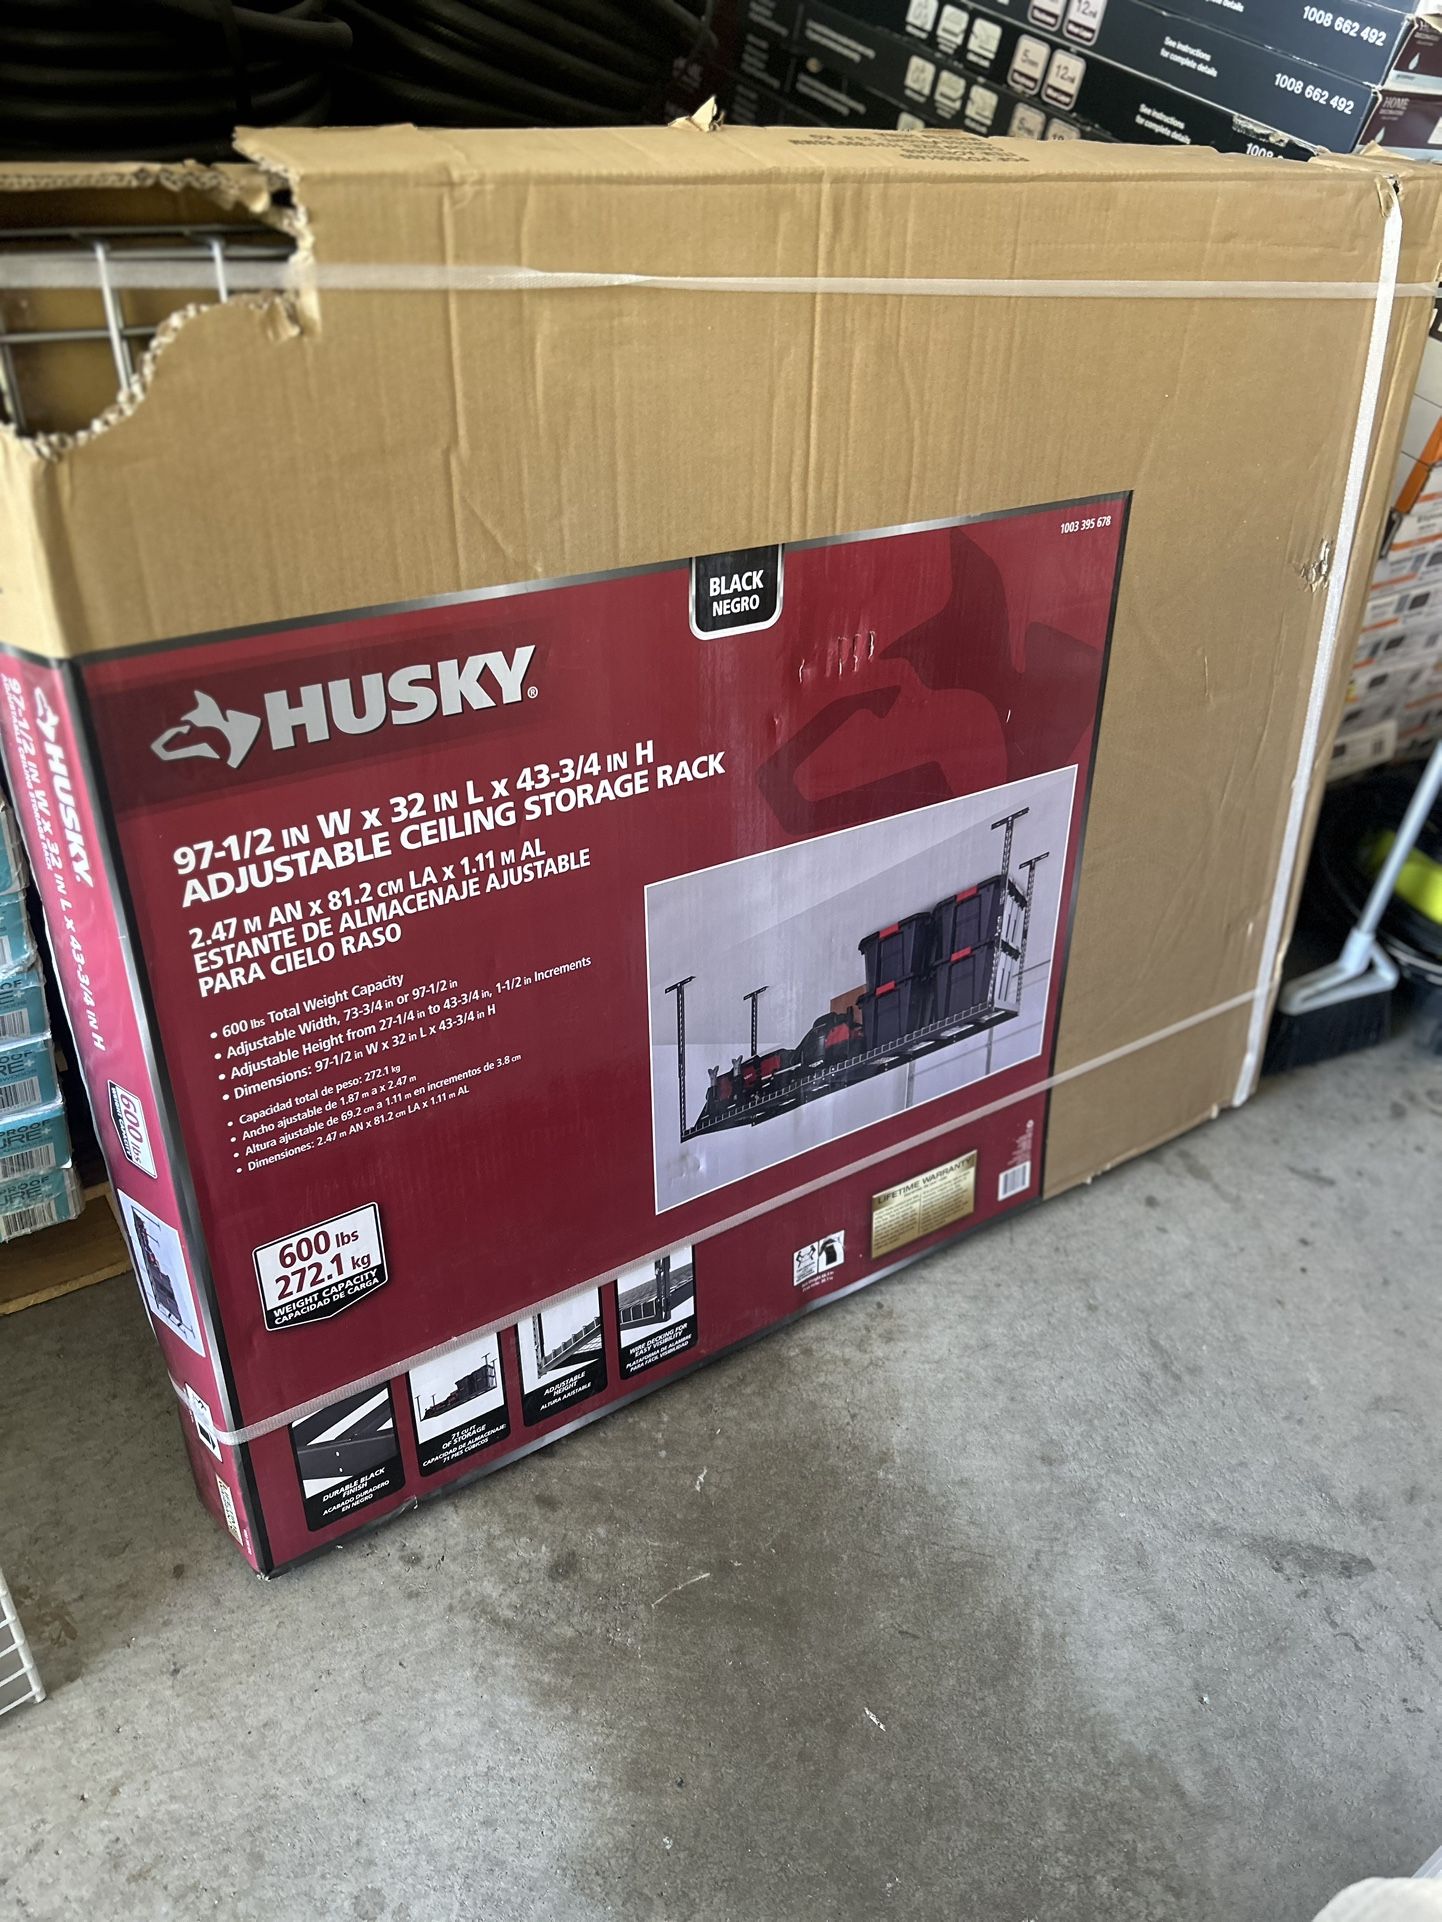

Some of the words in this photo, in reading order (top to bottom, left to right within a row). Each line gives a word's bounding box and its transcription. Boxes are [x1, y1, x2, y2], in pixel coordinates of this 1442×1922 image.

[1303, 5, 1333, 27] 1008
[1334, 15, 1358, 37] 662
[1360, 26, 1387, 47] 492
[1274, 72, 1304, 94] 1008
[1304, 84, 1329, 105] 662
[1329, 94, 1355, 115] 492
[1060, 520, 1079, 534] 1003
[1079, 517, 1095, 530] 395
[1096, 514, 1111, 527] 678
[709, 569, 764, 597] BLACK
[712, 593, 760, 616] NEGRO
[263, 645, 533, 750] HUSKY
[43, 740, 94, 888] HUSKY
[172, 827, 275, 875] 97-1/2
[281, 823, 310, 848] IN
[316, 807, 351, 839] W
[360, 807, 382, 830] x
[389, 791, 426, 823] 32
[432, 789, 458, 812] IN
[465, 779, 484, 805] L
[490, 777, 509, 799] x
[515, 751, 601, 791] 43-3/4
[606, 750, 627, 772] IN
[635, 739, 653, 765] H
[181, 830, 392, 908] ADJUSTABLE
[399, 800, 516, 849] CEILING
[523, 768, 649, 820] STORAGE
[656, 750, 725, 789] RACK
[188, 916, 237, 949] 2.47
[242, 915, 262, 934] M
[267, 899, 303, 928] AN
[307, 898, 323, 917] x
[327, 881, 373, 910] 81.2
[376, 877, 403, 897] CM
[408, 865, 437, 890] LA
[441, 864, 455, 881] x
[459, 849, 494, 875] 1.11
[500, 848, 515, 866] M
[520, 837, 546, 861] AL
[193, 926, 297, 973] ESTANTE
[301, 916, 333, 943] DE
[338, 876, 480, 933] ALMACENAJE
[485, 847, 590, 893] AJUSTABLE
[198, 961, 266, 997] PARA
[269, 941, 335, 975] CIELO
[340, 922, 401, 956] RASO
[221, 1019, 248, 1037] 600
[249, 1018, 265, 1029] lbs
[266, 1002, 300, 1023] Total
[302, 989, 349, 1012] Weight
[350, 974, 403, 997] Capacity
[226, 1027, 296, 1059] Adjustable
[297, 1013, 340, 1035] Width,
[342, 999, 383, 1021] 73-3/4
[384, 999, 394, 1008] in
[396, 992, 409, 1004] or
[411, 979, 447, 1000] 97-1/2
[448, 979, 458, 988] in
[230, 1048, 299, 1079] Adjustable
[301, 1033, 344, 1055] Height
[345, 1024, 376, 1041] from
[378, 1009, 415, 1031] 27-1/4
[416, 1009, 425, 1019] in
[427, 1003, 440, 1015] to
[442, 989, 480, 1009] 43-3/4
[480, 989, 492, 998] in,
[495, 975, 521, 993] 1-1/2
[523, 976, 532, 985] in
[533, 956, 591, 982] Increments
[233, 1065, 312, 1099] Dimensions:
[314, 1050, 352, 1072] 97-1/2
[353, 1049, 363, 1059] in
[364, 1040, 378, 1055] W
[381, 1040, 389, 1051] x
[391, 1032, 406, 1047] 32
[407, 1032, 417, 1042] in
[419, 1026, 427, 1038] L
[428, 1024, 436, 1035] x
[438, 1010, 475, 1030] 43-3/4
[476, 1010, 485, 1019] in
[486, 1003, 496, 1015] H
[238, 1097, 292, 1124] Capacidad
[293, 1088, 318, 1105] total
[320, 1085, 334, 1096] de
[335, 1076, 362, 1094] peso:
[363, 1065, 389, 1082] 272.1
[390, 1064, 401, 1073] kg
[242, 1123, 275, 1141] Ancho
[276, 1105, 323, 1129] ajustable
[324, 1100, 337, 1111] de
[339, 1090, 359, 1105] 1.87
[370, 1087, 378, 1095] a
[379, 1084, 386, 1092] x
[387, 1074, 407, 1090] 2.47
[119, 1093, 144, 1144] 600
[130, 1140, 142, 1164] lbs
[878, 1182, 918, 1204] LIFETIME
[923, 1158, 971, 1184] WARRANTY
[279, 1230, 331, 1269] 600
[335, 1229, 359, 1248] lbs
[274, 1293, 320, 1317] WEIGHT
[322, 1269, 377, 1296] CAPACITY
[275, 1253, 344, 1301] 272.1
[351, 1253, 371, 1271] kg
[275, 1299, 330, 1325] CAPACIDAD
[333, 1291, 345, 1301] DE
[348, 1278, 378, 1295] CARGA
[544, 1371, 586, 1396] ADJUSTABLE
[553, 1380, 577, 1396] HEIGHT
[453, 1424, 487, 1445] STORAGE
[322, 1480, 359, 1502] DURABLE
[360, 1467, 385, 1483] BLACK
[322, 1497, 354, 1515] ACABADO
[355, 1480, 390, 1500] DURADERO
[341, 1504, 350, 1512] EN
[351, 1494, 373, 1507] NEGRO
[342, 1482, 368, 1498] FINISH
